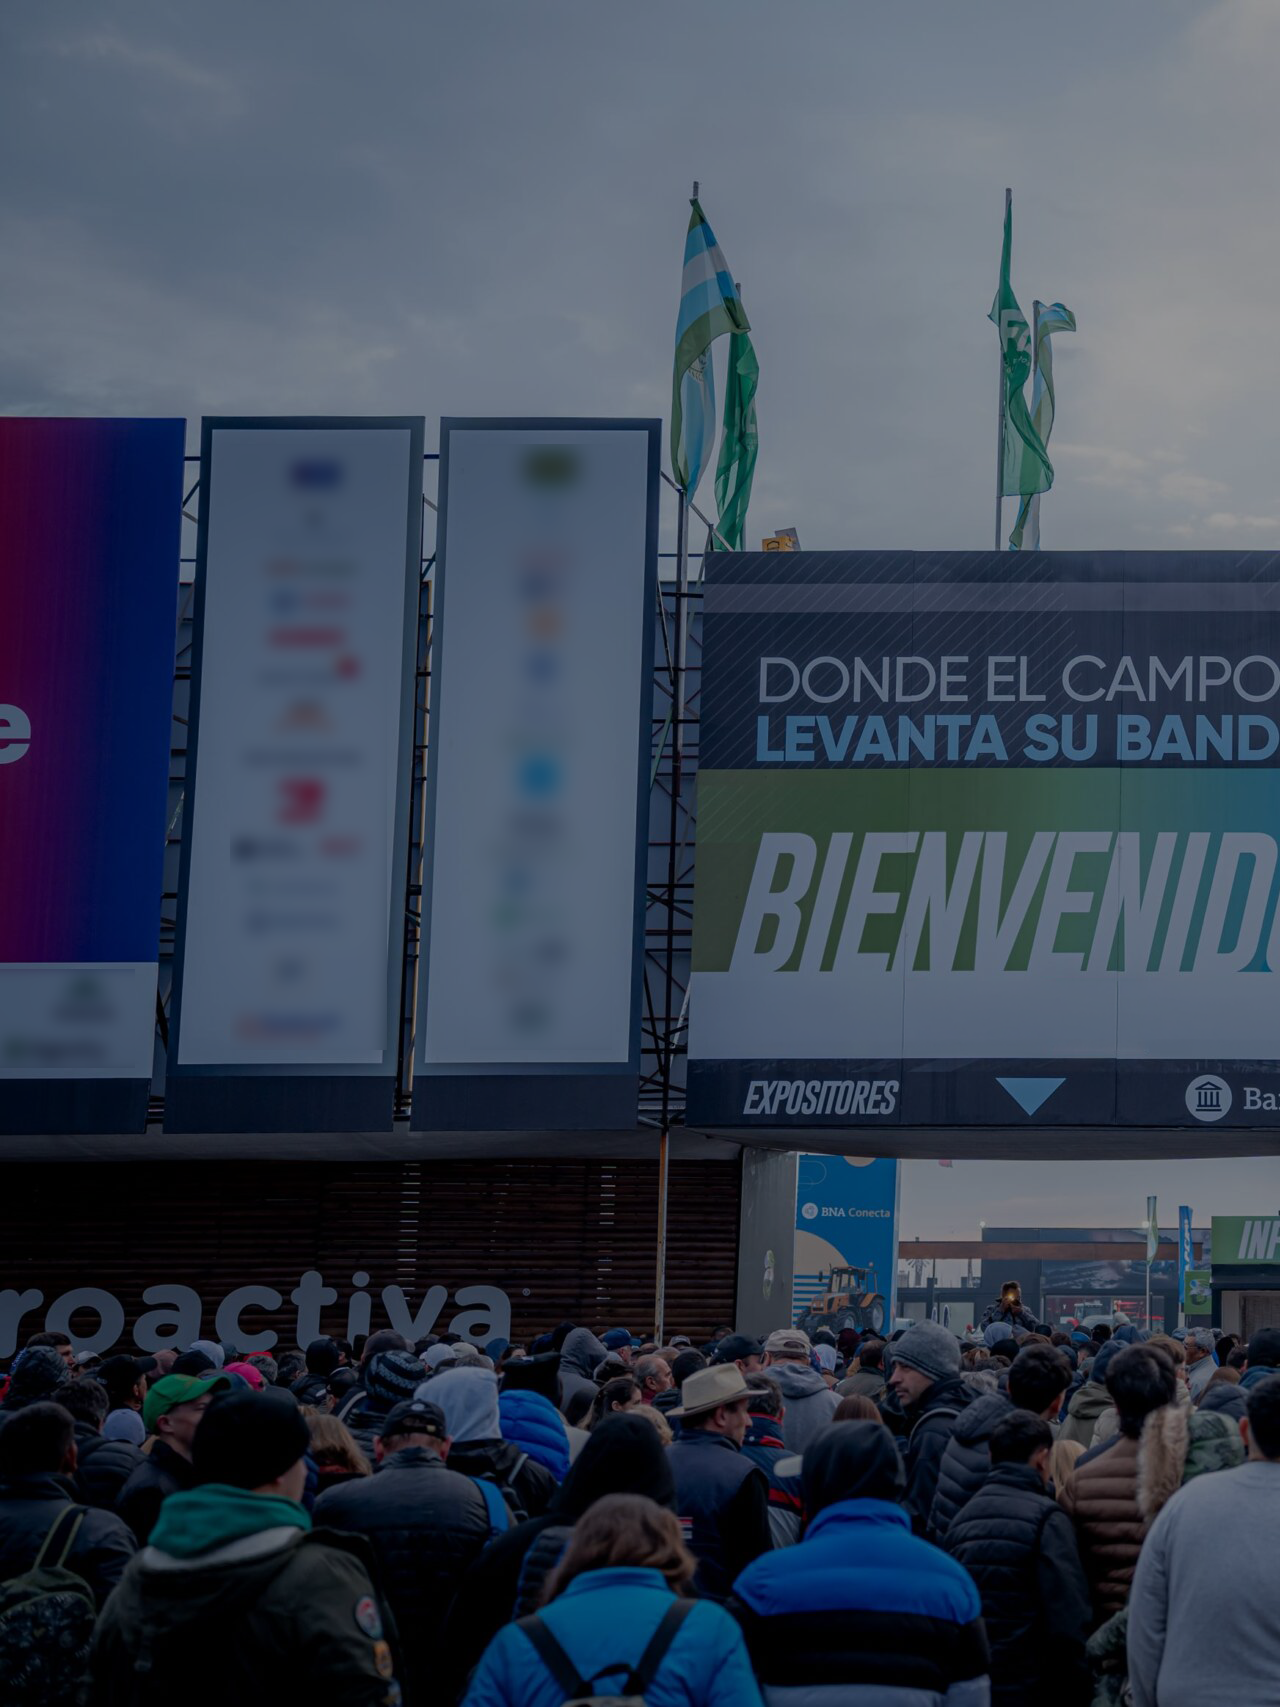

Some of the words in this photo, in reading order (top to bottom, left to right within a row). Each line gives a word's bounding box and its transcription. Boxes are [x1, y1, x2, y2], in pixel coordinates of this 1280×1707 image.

[760, 656, 968, 702] DONDE
[988, 656, 1045, 702] EL
[1062, 655, 1280, 702] CAMPO
[757, 715, 1008, 762] LEVANTA
[1024, 714, 1098, 762] SU
[743, 1080, 900, 1116] EXPOSITORES
[821, 1206, 846, 1217] BNA
[848, 1207, 891, 1218] Conecta
